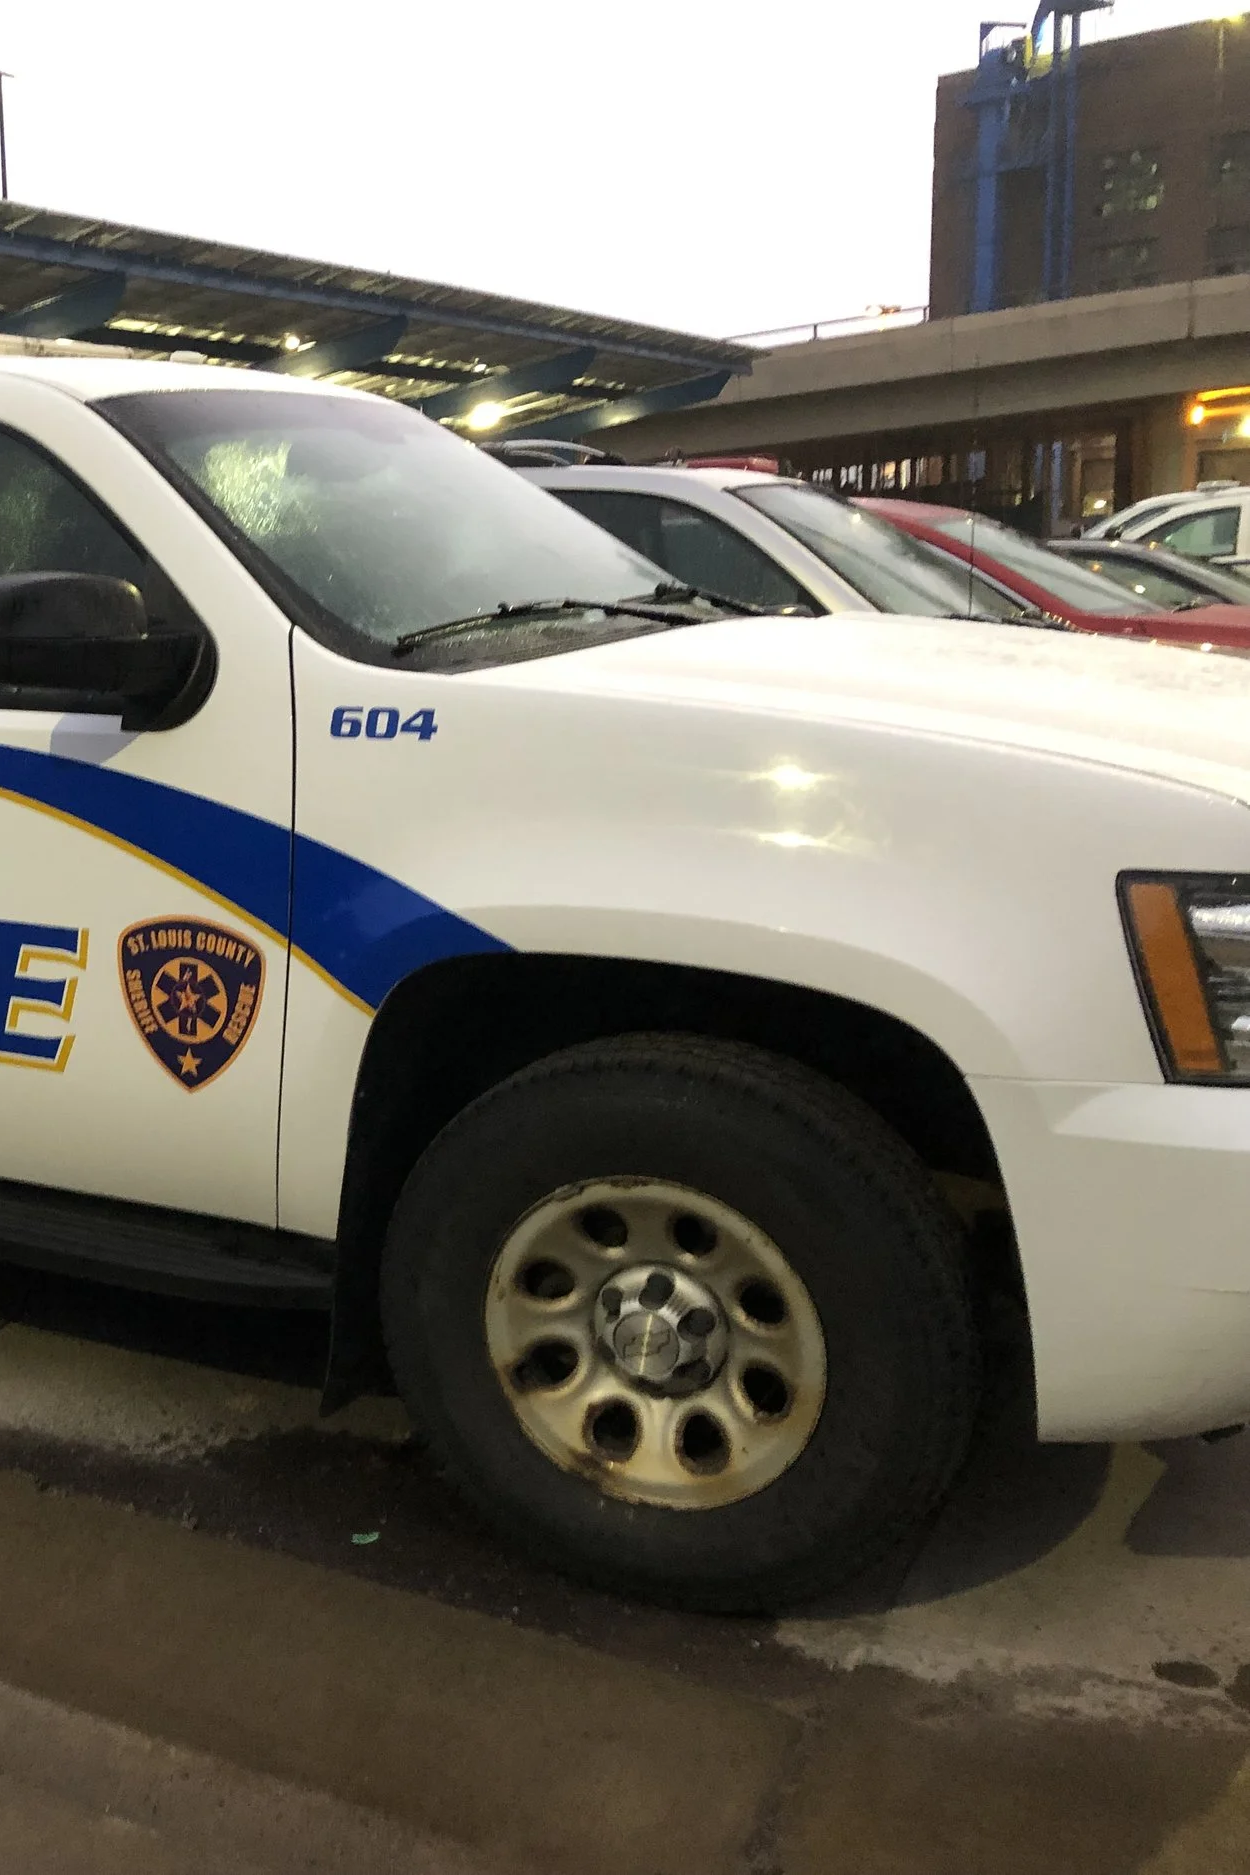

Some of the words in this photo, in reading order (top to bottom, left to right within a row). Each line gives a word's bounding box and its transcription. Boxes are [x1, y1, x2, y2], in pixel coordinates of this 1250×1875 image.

[330, 706, 438, 740] 604
[151, 928, 192, 951] LOUIS
[196, 931, 256, 968] COUNTY
[126, 968, 159, 1034] SHERIFF
